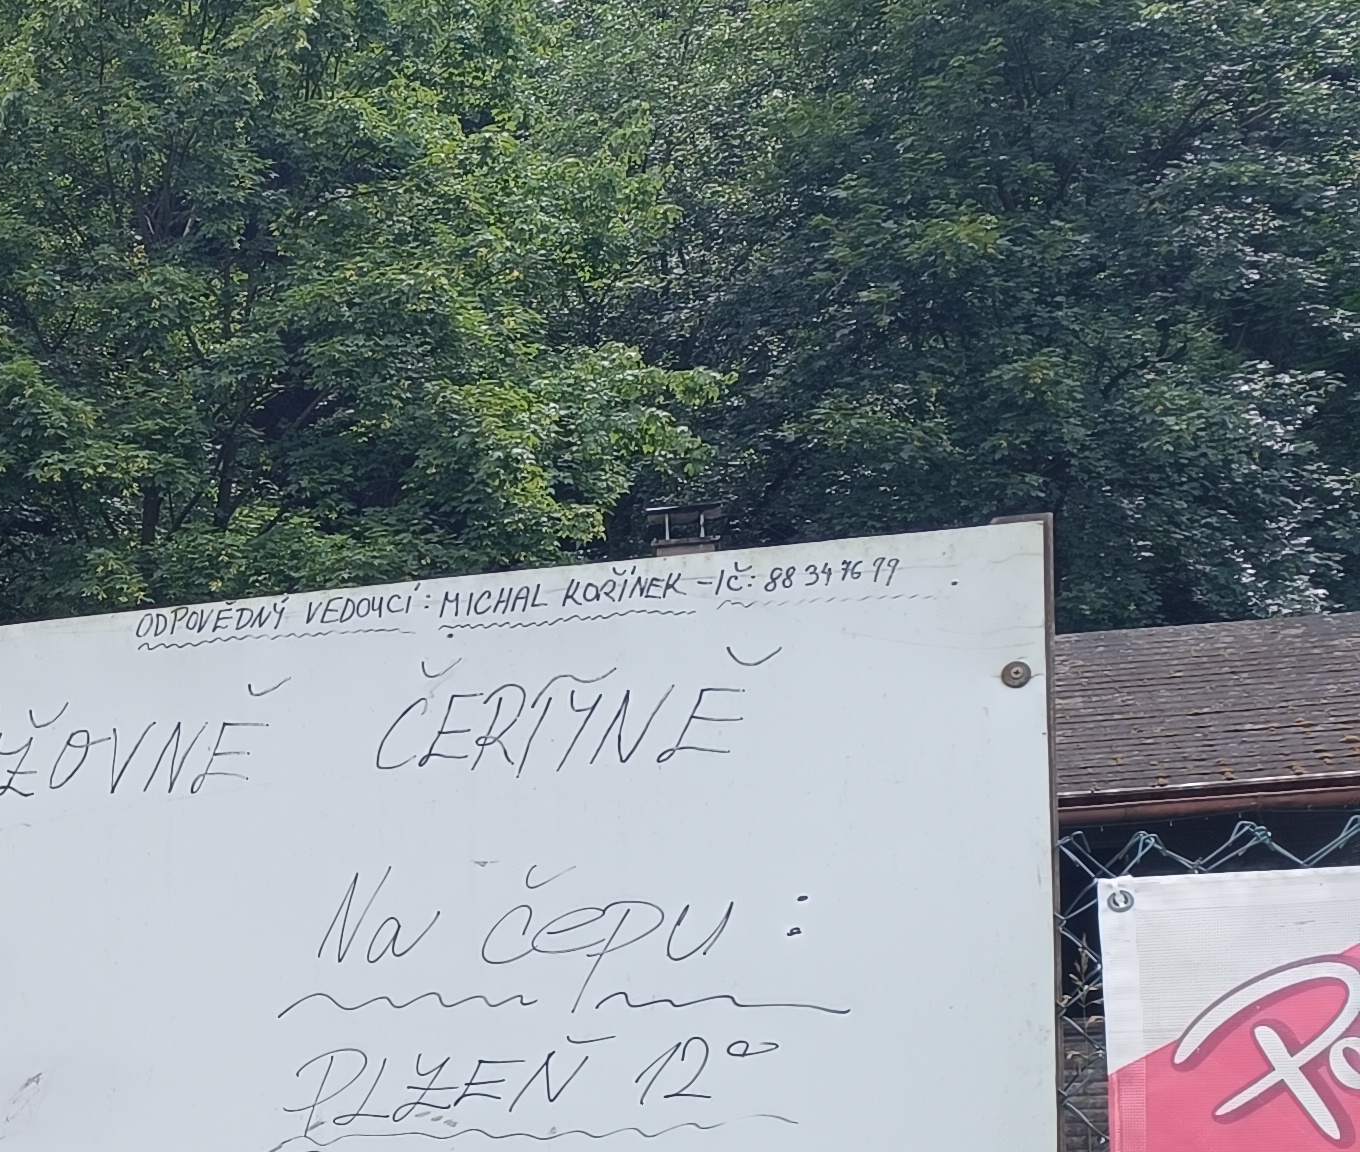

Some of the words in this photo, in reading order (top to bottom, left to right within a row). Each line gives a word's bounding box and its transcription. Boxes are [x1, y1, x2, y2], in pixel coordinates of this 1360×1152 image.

[135, 596, 289, 638] ODPOVĚDNÝ
[439, 584, 548, 618] MICHAL
[317, 865, 441, 964] Na
[283, 1035, 617, 1138] PLZEŇ
